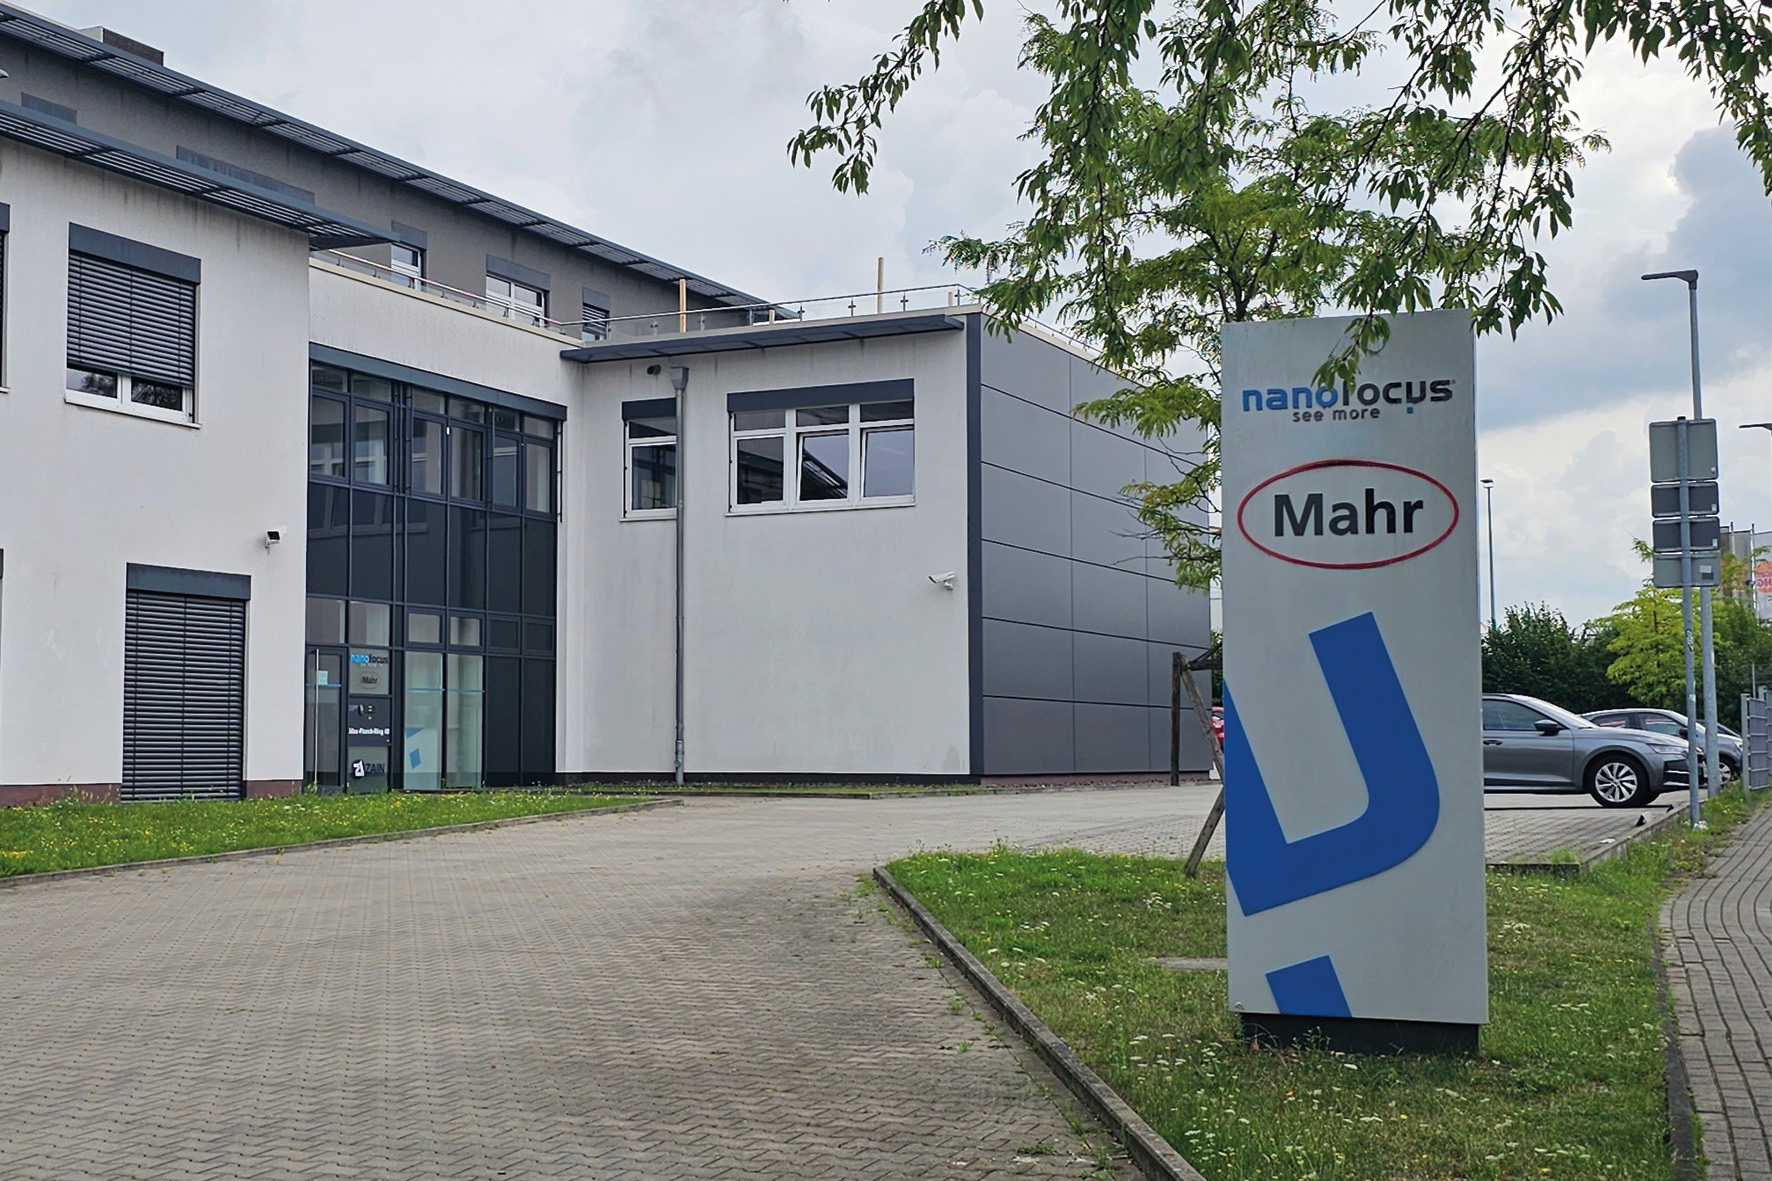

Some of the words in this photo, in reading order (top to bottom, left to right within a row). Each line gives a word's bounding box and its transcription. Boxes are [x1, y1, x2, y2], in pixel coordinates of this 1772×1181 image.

[1292, 411, 1324, 423] see
[1332, 407, 1381, 421] more
[1273, 488, 1424, 537] Mahr
